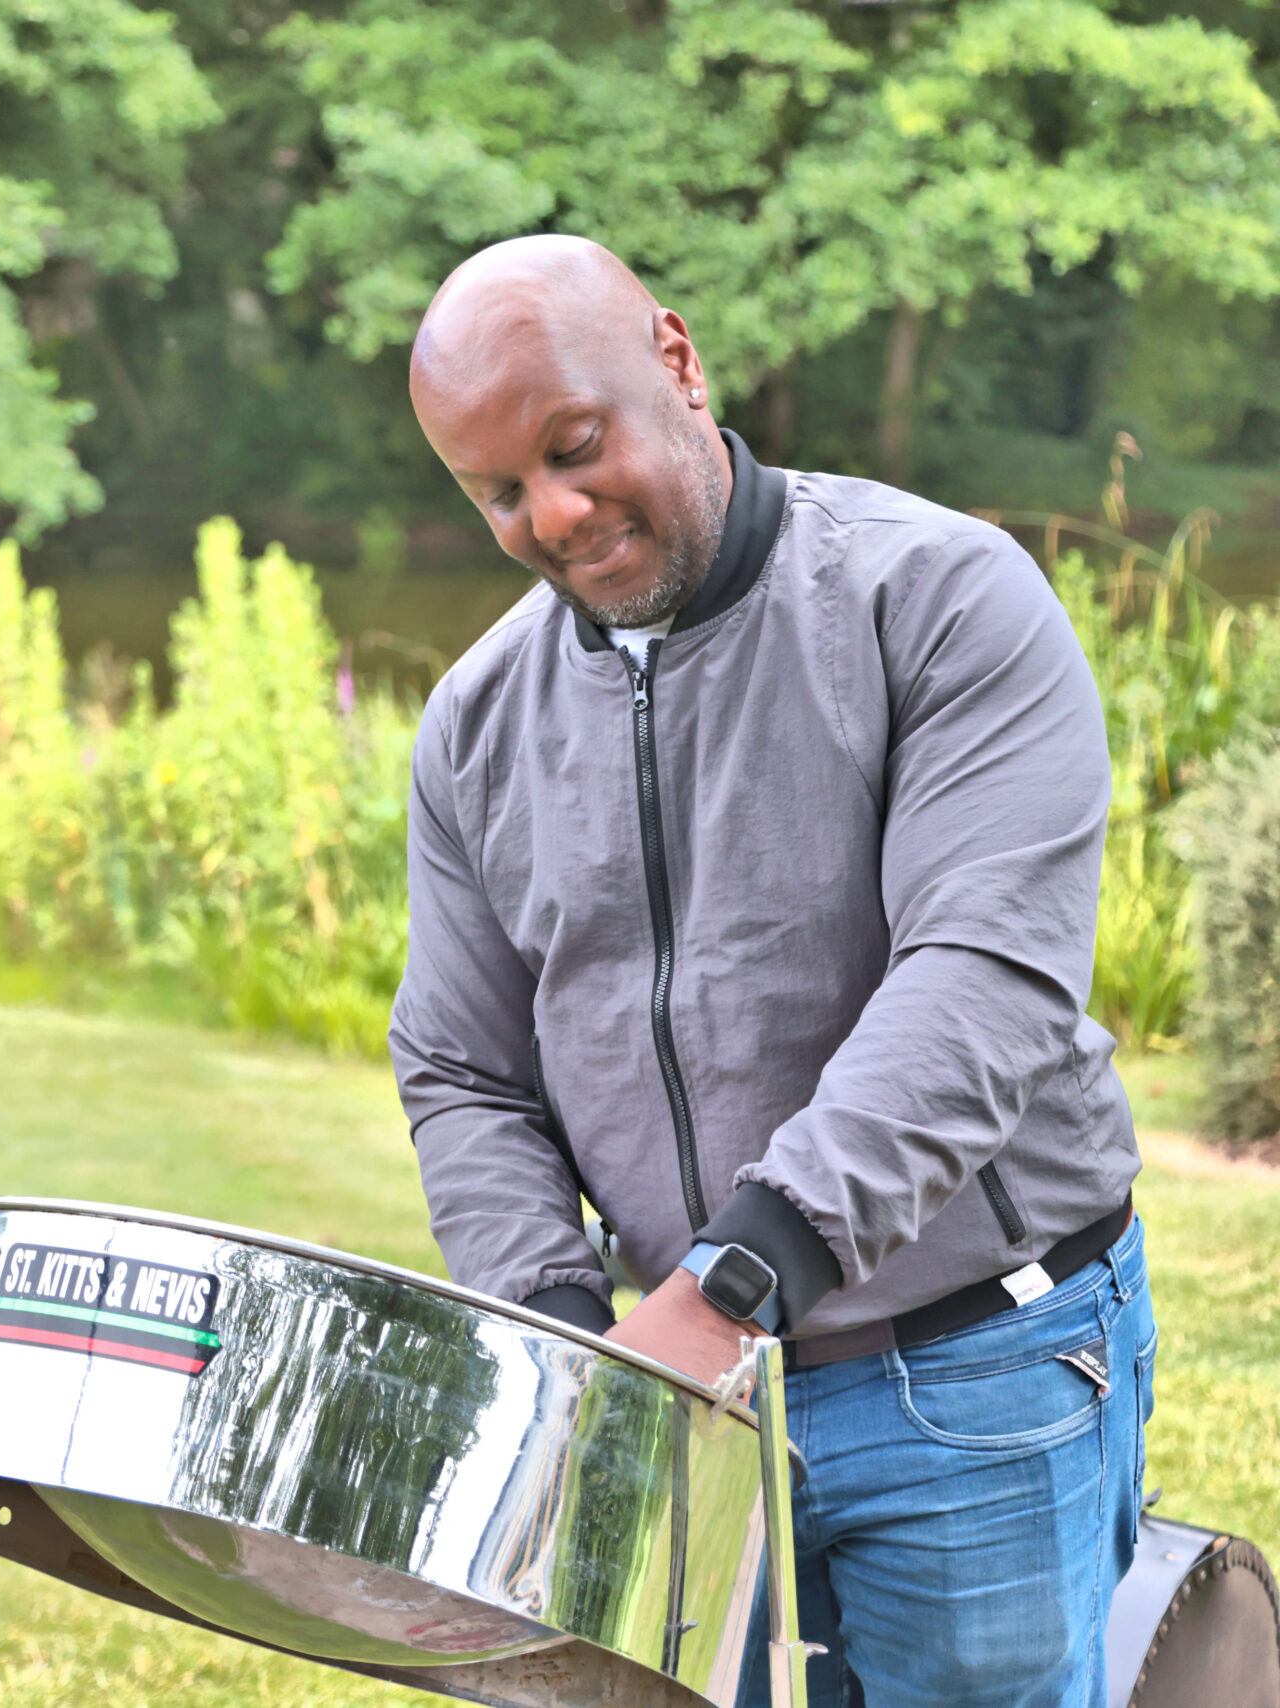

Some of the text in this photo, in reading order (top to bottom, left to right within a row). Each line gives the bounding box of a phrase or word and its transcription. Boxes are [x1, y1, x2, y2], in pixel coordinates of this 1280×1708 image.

[5, 1247, 212, 1325] ST. KITTS & NEVIS
[1080, 1349, 1109, 1377] REPLAY
